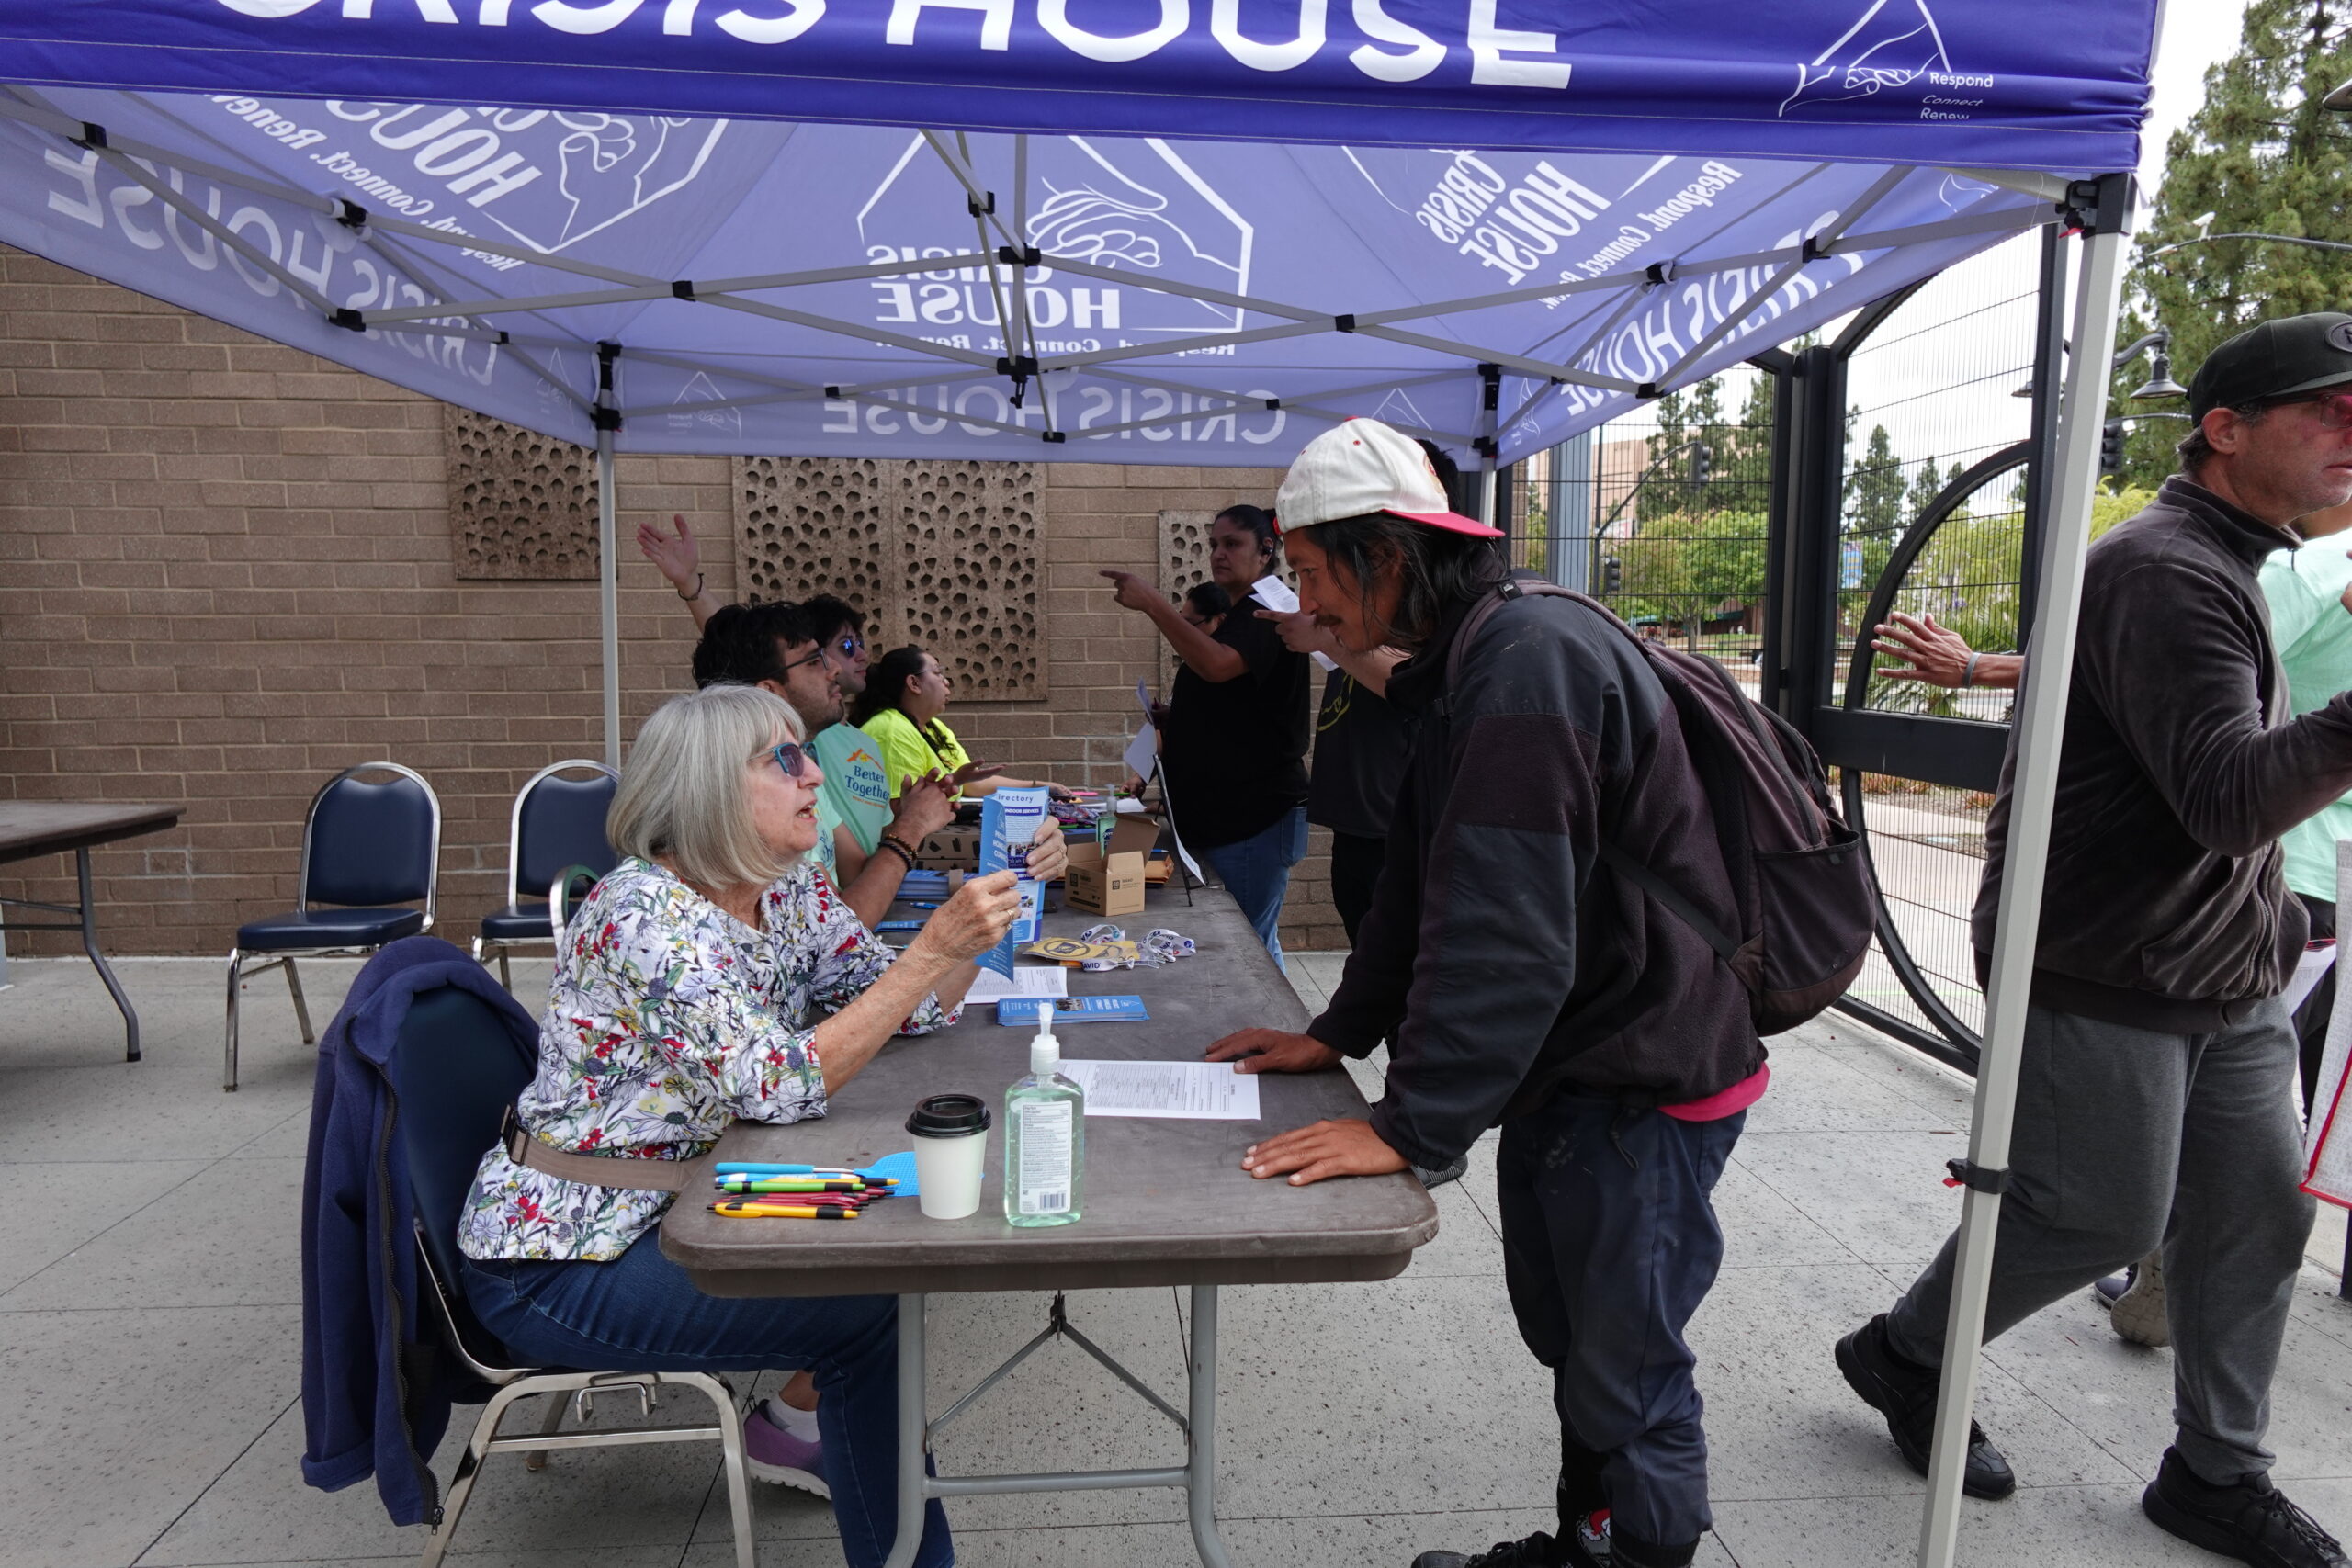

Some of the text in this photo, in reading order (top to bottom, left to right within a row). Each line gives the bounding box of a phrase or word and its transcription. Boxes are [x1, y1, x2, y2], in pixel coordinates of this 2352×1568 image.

[1930, 73, 1994, 90] Respond
[1922, 95, 1984, 107] Connect
[1920, 107, 1970, 120] Renew
[854, 765, 885, 784] Better
[998, 794, 1034, 804] irectory
